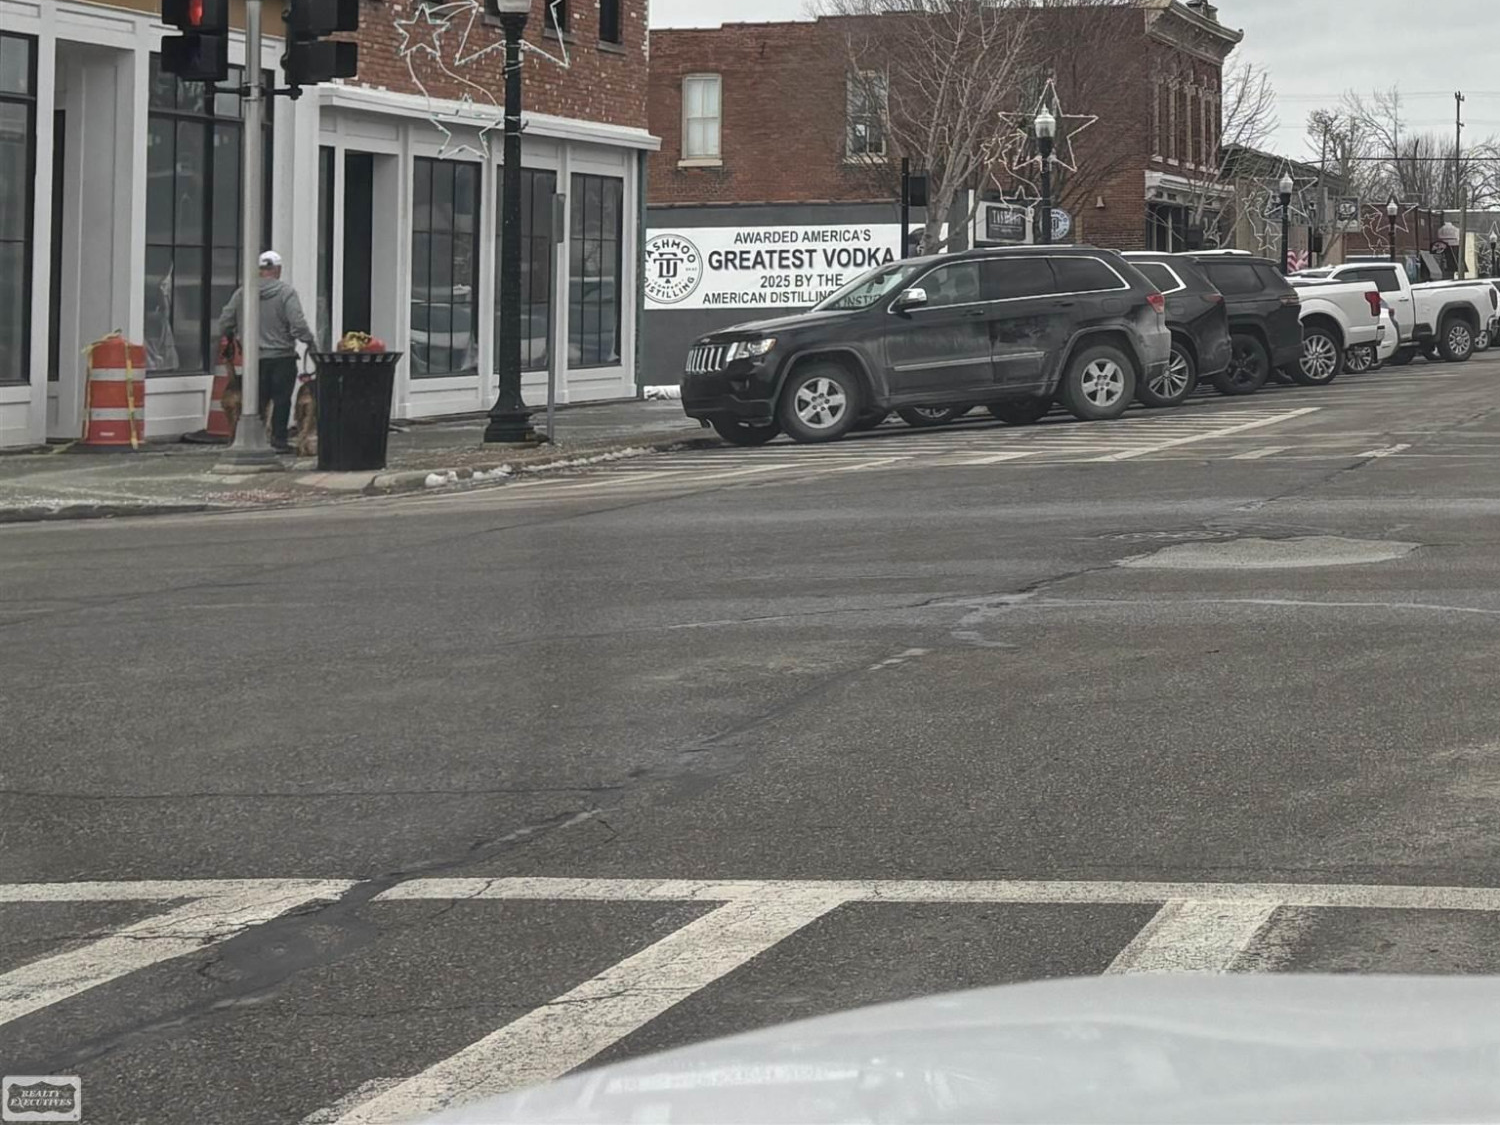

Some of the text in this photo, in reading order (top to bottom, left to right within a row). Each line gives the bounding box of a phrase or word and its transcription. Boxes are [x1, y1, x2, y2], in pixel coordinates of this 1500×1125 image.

[734, 229, 871, 245] AWARDED AMERICA'S
[708, 246, 895, 271] GREATEST VODKA
[760, 273, 844, 289] 2025 BY THE
[702, 291, 767, 305] AMERICAN
